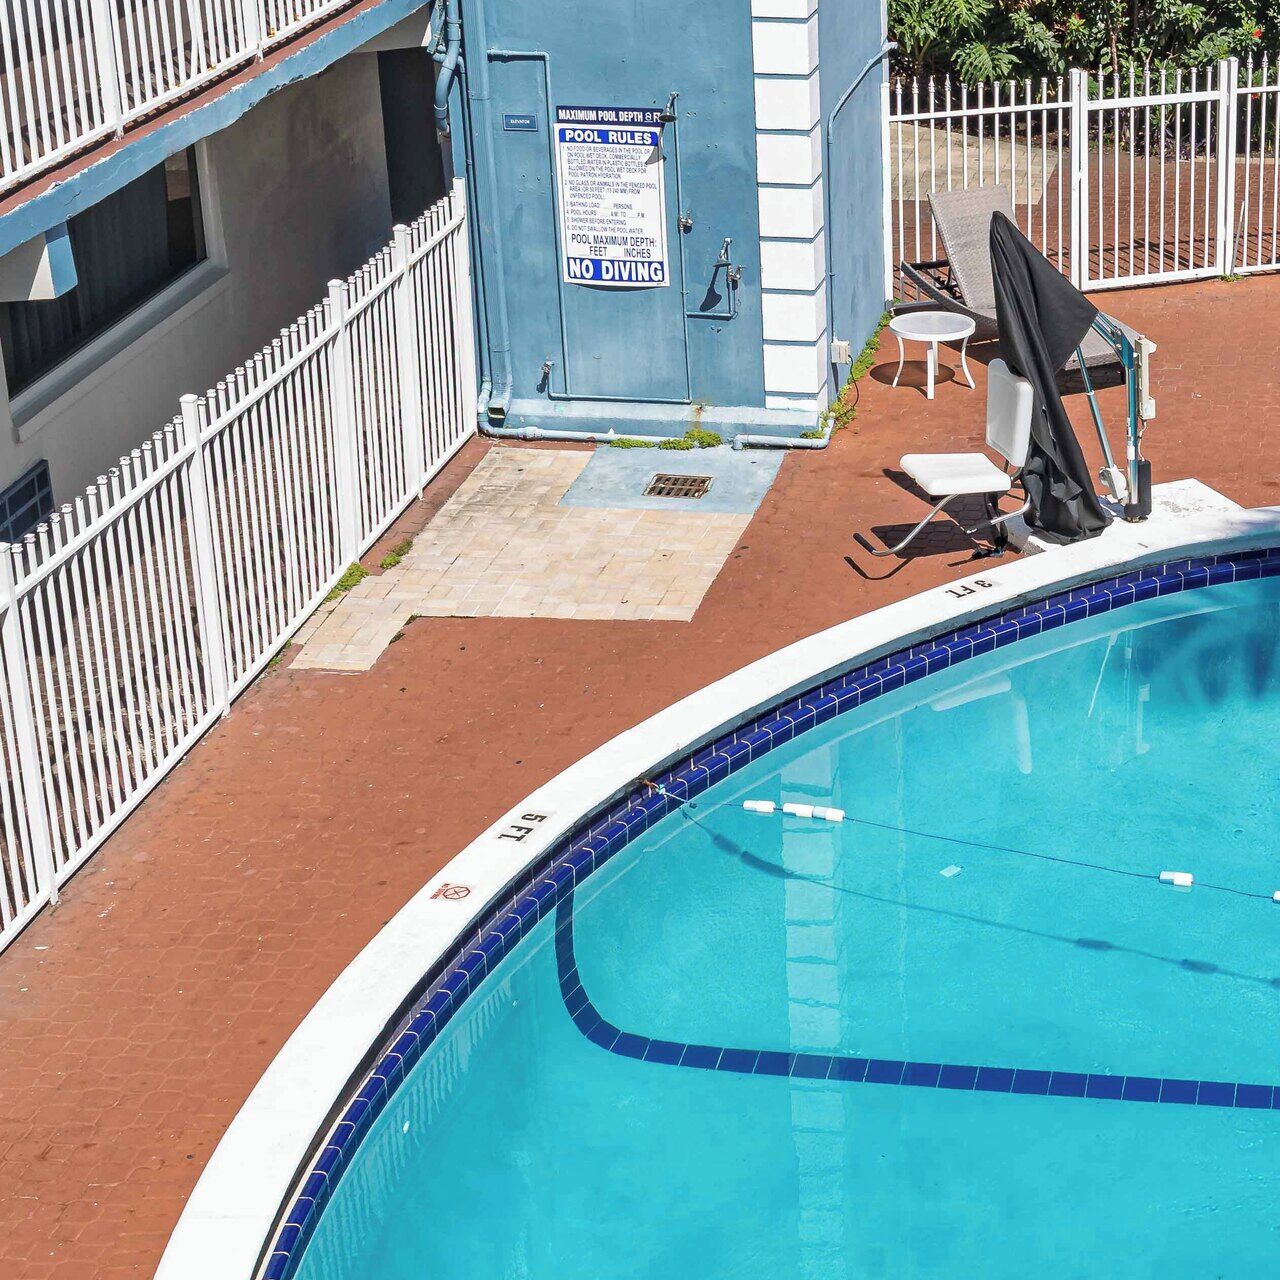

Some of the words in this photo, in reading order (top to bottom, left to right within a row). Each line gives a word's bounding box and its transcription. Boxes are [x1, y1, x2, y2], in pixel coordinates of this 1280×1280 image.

[558, 109, 597, 121] MAXIMUM
[598, 111, 616, 122] POOL
[618, 111, 643, 122] DEPTH
[565, 130, 602, 142] POOL
[608, 131, 652, 145] RULES
[571, 234, 592, 245] POOL
[593, 235, 628, 246] MAXIMUM
[630, 237, 657, 248] DEPTH:
[590, 246, 608, 256] FEET
[624, 248, 652, 258] INCHES
[569, 258, 594, 278] NO
[602, 260, 663, 281] DIVING
[974, 580, 993, 588] 3
[521, 813, 548, 823] 5
